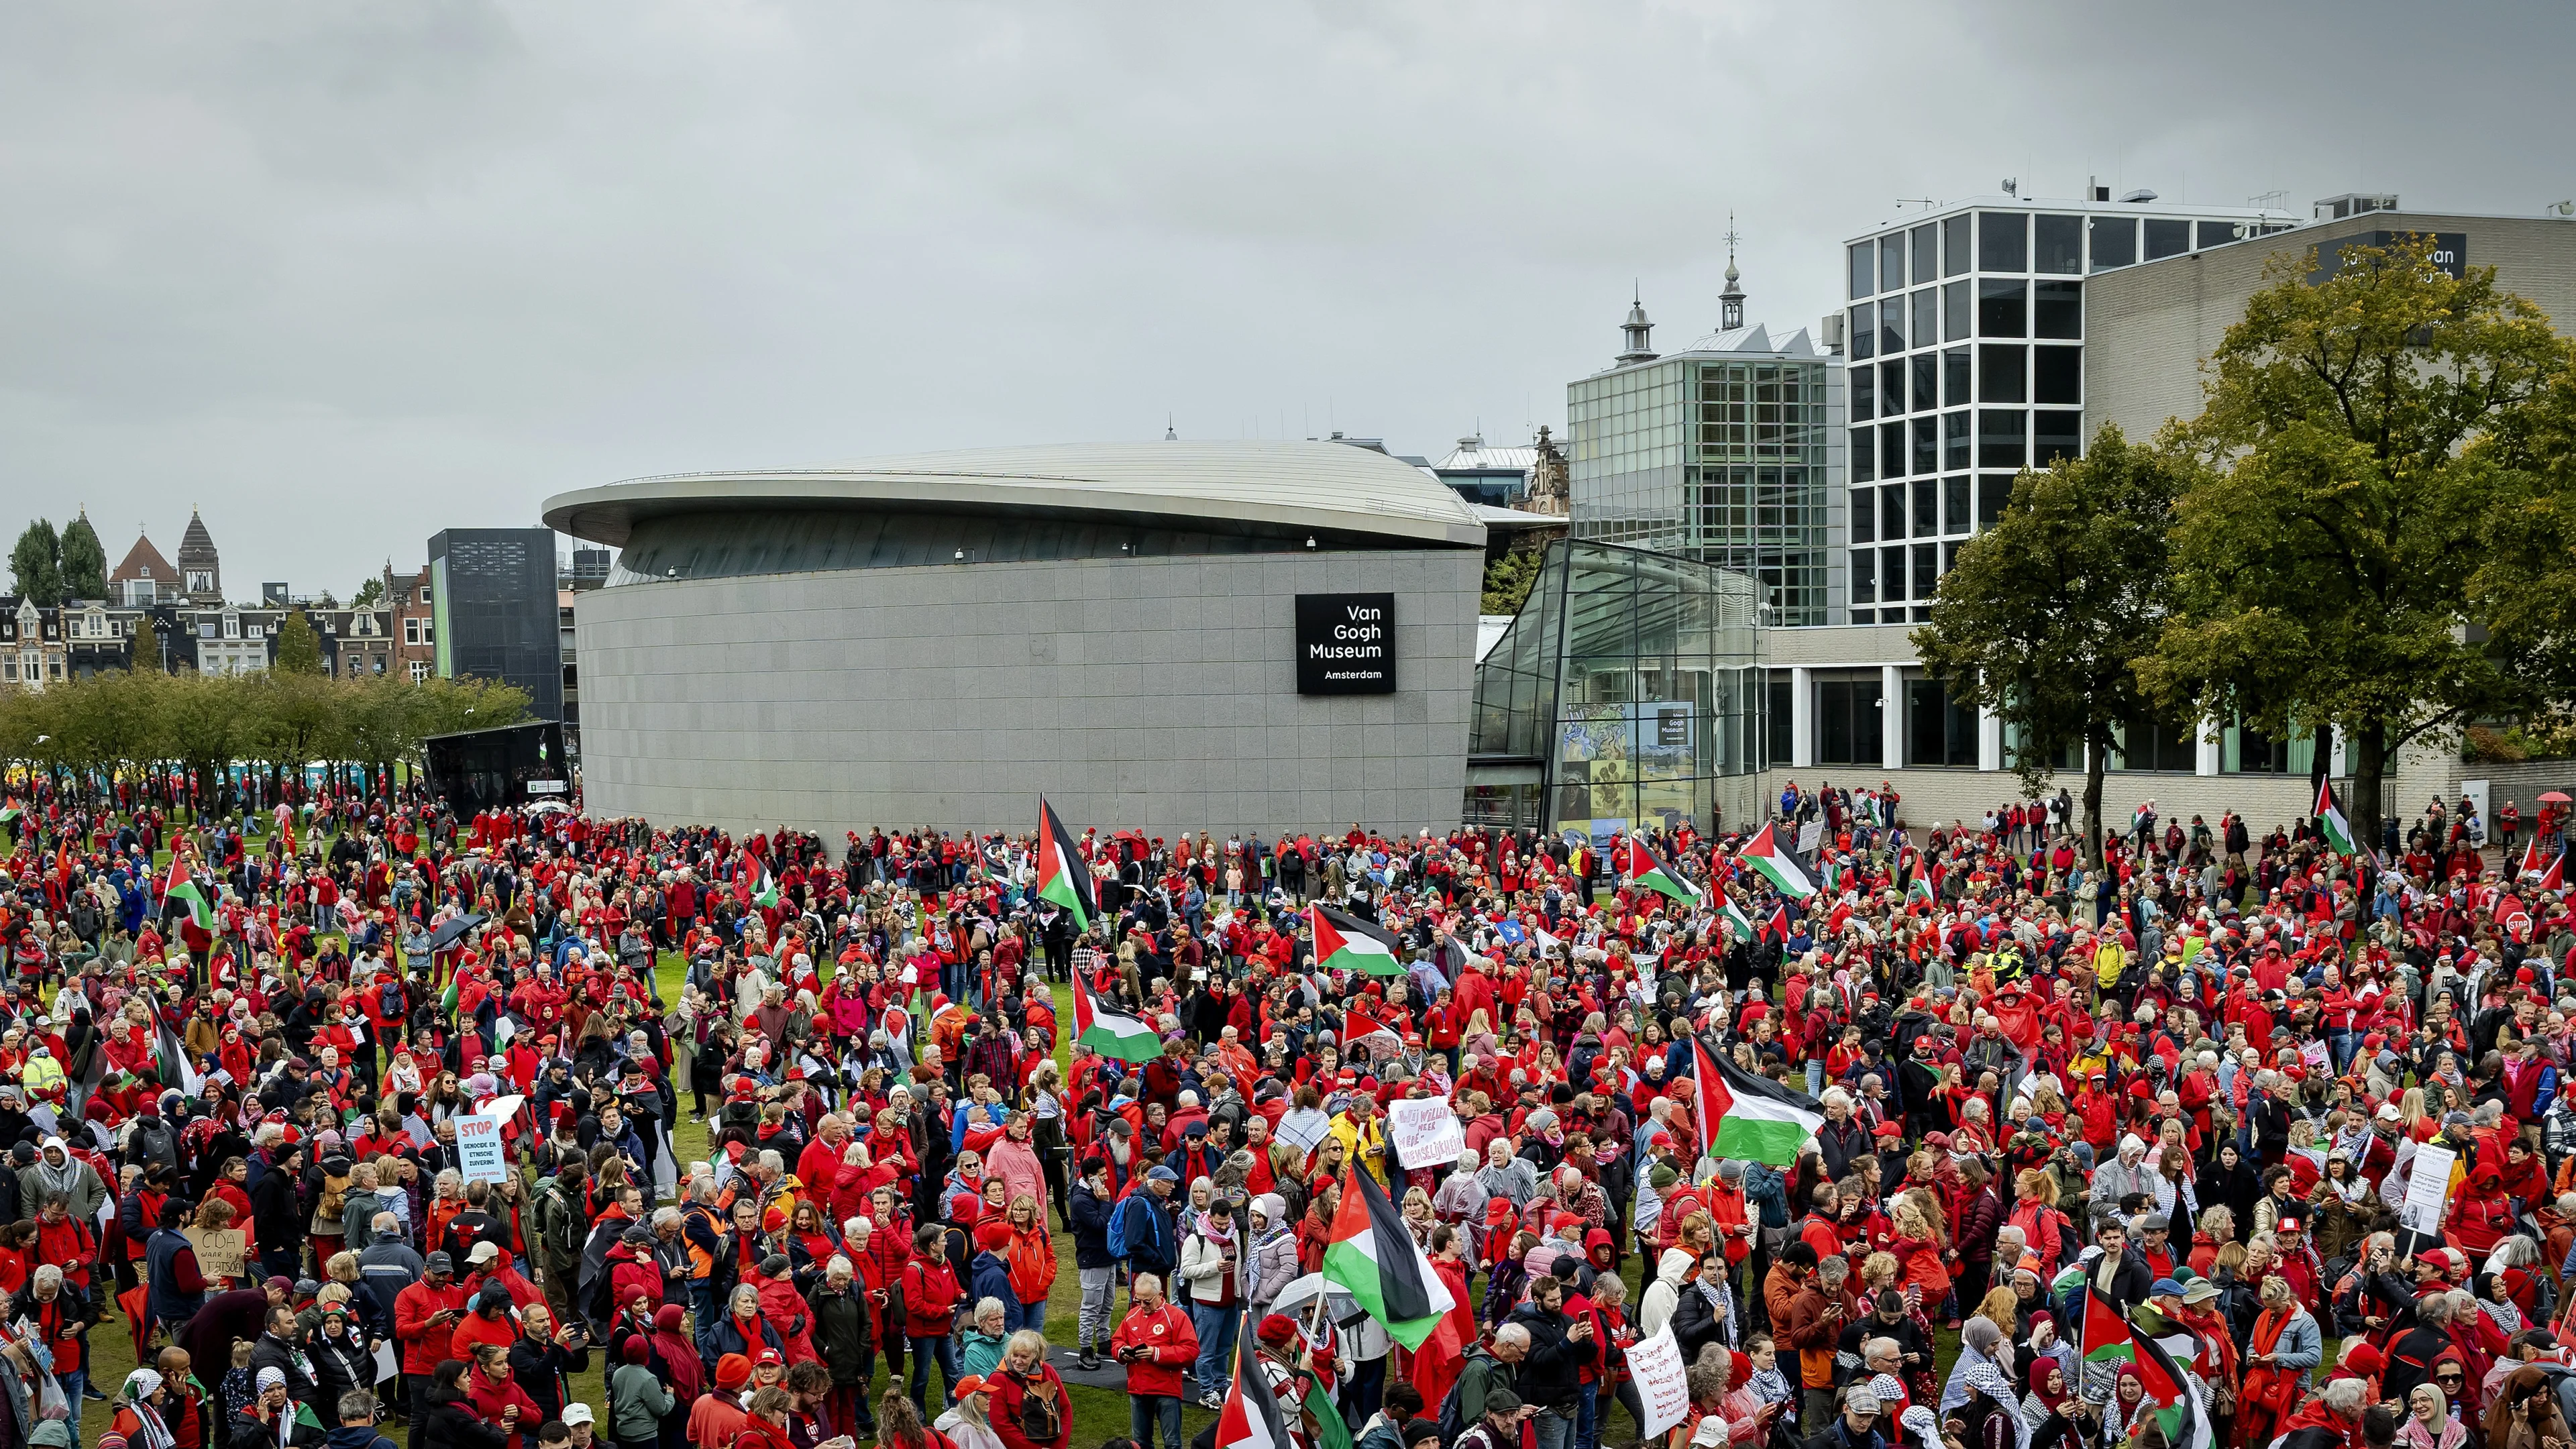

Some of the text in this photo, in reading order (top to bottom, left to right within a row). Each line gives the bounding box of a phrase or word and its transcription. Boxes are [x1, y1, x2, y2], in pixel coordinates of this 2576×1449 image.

[1347, 606, 1381, 621] Van
[1334, 624, 1381, 641] Gogh
[1310, 644, 1381, 659] Museum
[1325, 670, 1382, 680] Amsterdam
[2510, 920, 2528, 929] STOP
[461, 1120, 492, 1137] STOP
[1417, 1122, 1436, 1132] MEER
[202, 1232, 235, 1248] CDA
[207, 1261, 243, 1273] FATSOEN
